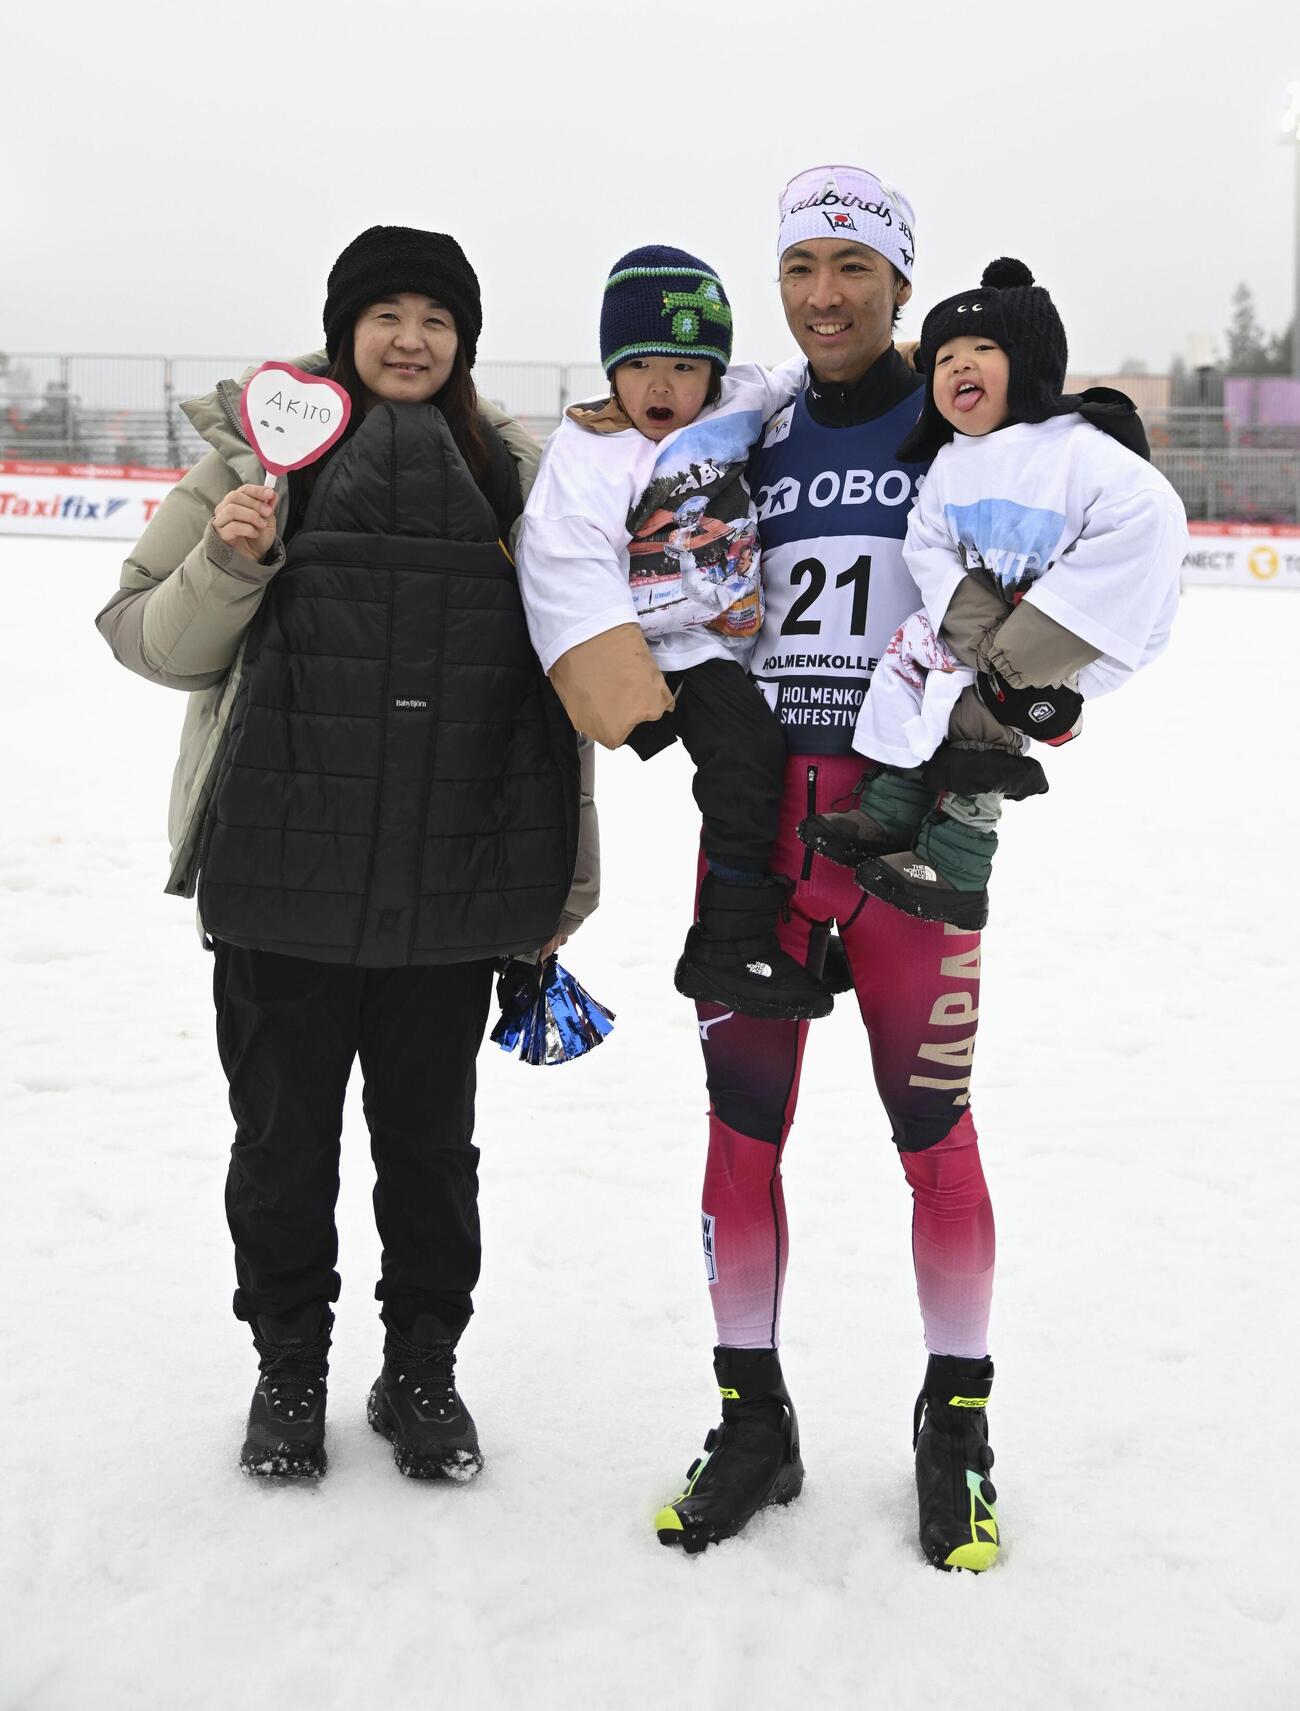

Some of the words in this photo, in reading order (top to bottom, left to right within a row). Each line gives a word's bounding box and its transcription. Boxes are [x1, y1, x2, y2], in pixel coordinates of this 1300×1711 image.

[266, 391, 331, 423] AKITO
[0, 493, 100, 519] Taxifix
[780, 553, 872, 636] 21
[762, 654, 882, 671] HOLMENKOLLE
[782, 686, 868, 706] HOLMENKO
[909, 922, 981, 1106] JAPA
